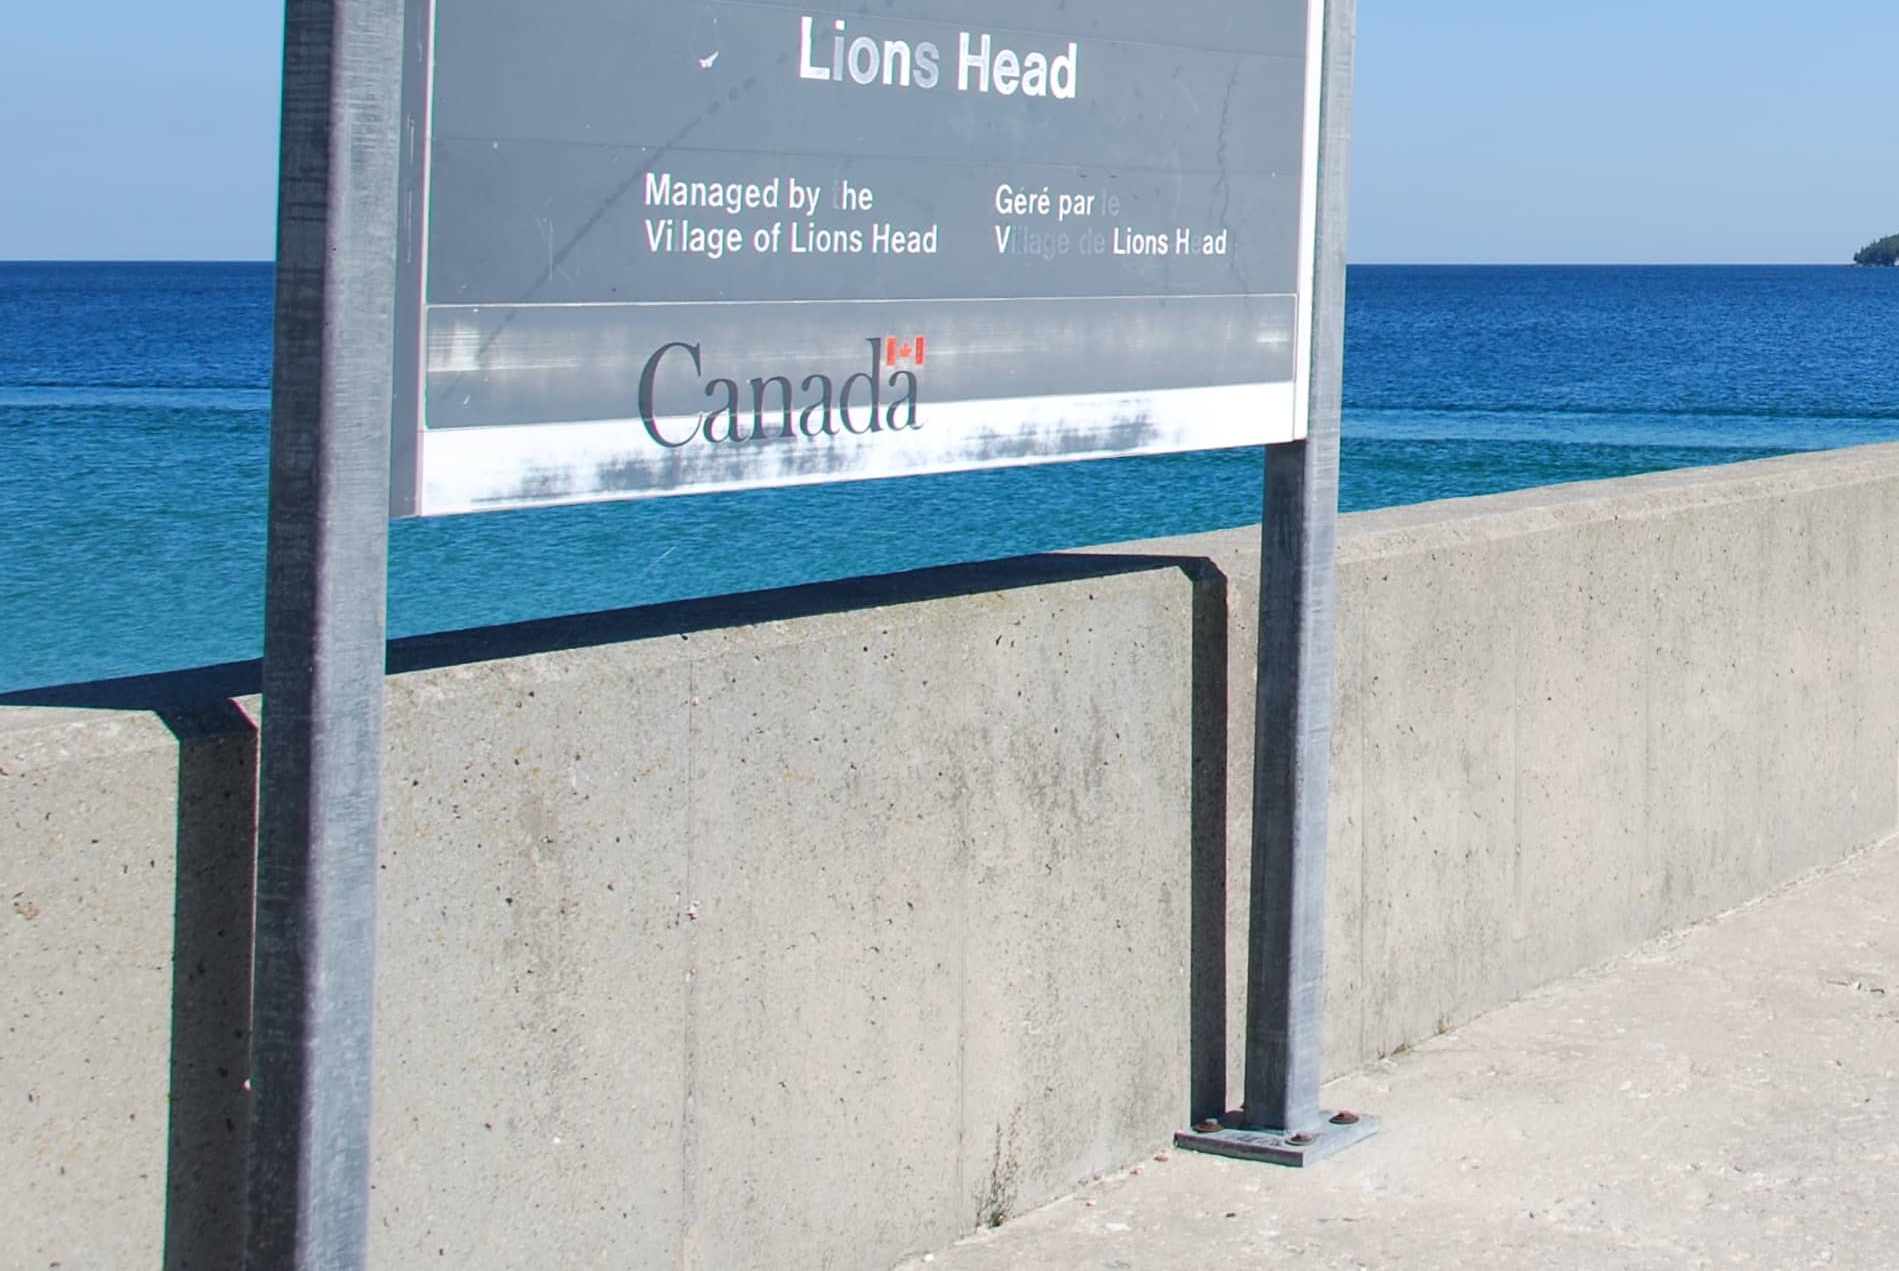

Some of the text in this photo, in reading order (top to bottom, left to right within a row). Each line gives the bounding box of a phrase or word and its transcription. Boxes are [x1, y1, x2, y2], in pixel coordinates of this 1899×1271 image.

[799, 15, 1078, 99] Lions Head
[643, 171, 779, 215] Managed
[788, 176, 821, 217] by
[994, 182, 1051, 216] Géré
[1058, 192, 1096, 222] par
[643, 218, 938, 260] Village of Lions Head
[1112, 226, 1169, 256] Lions
[637, 335, 925, 449] Canada
